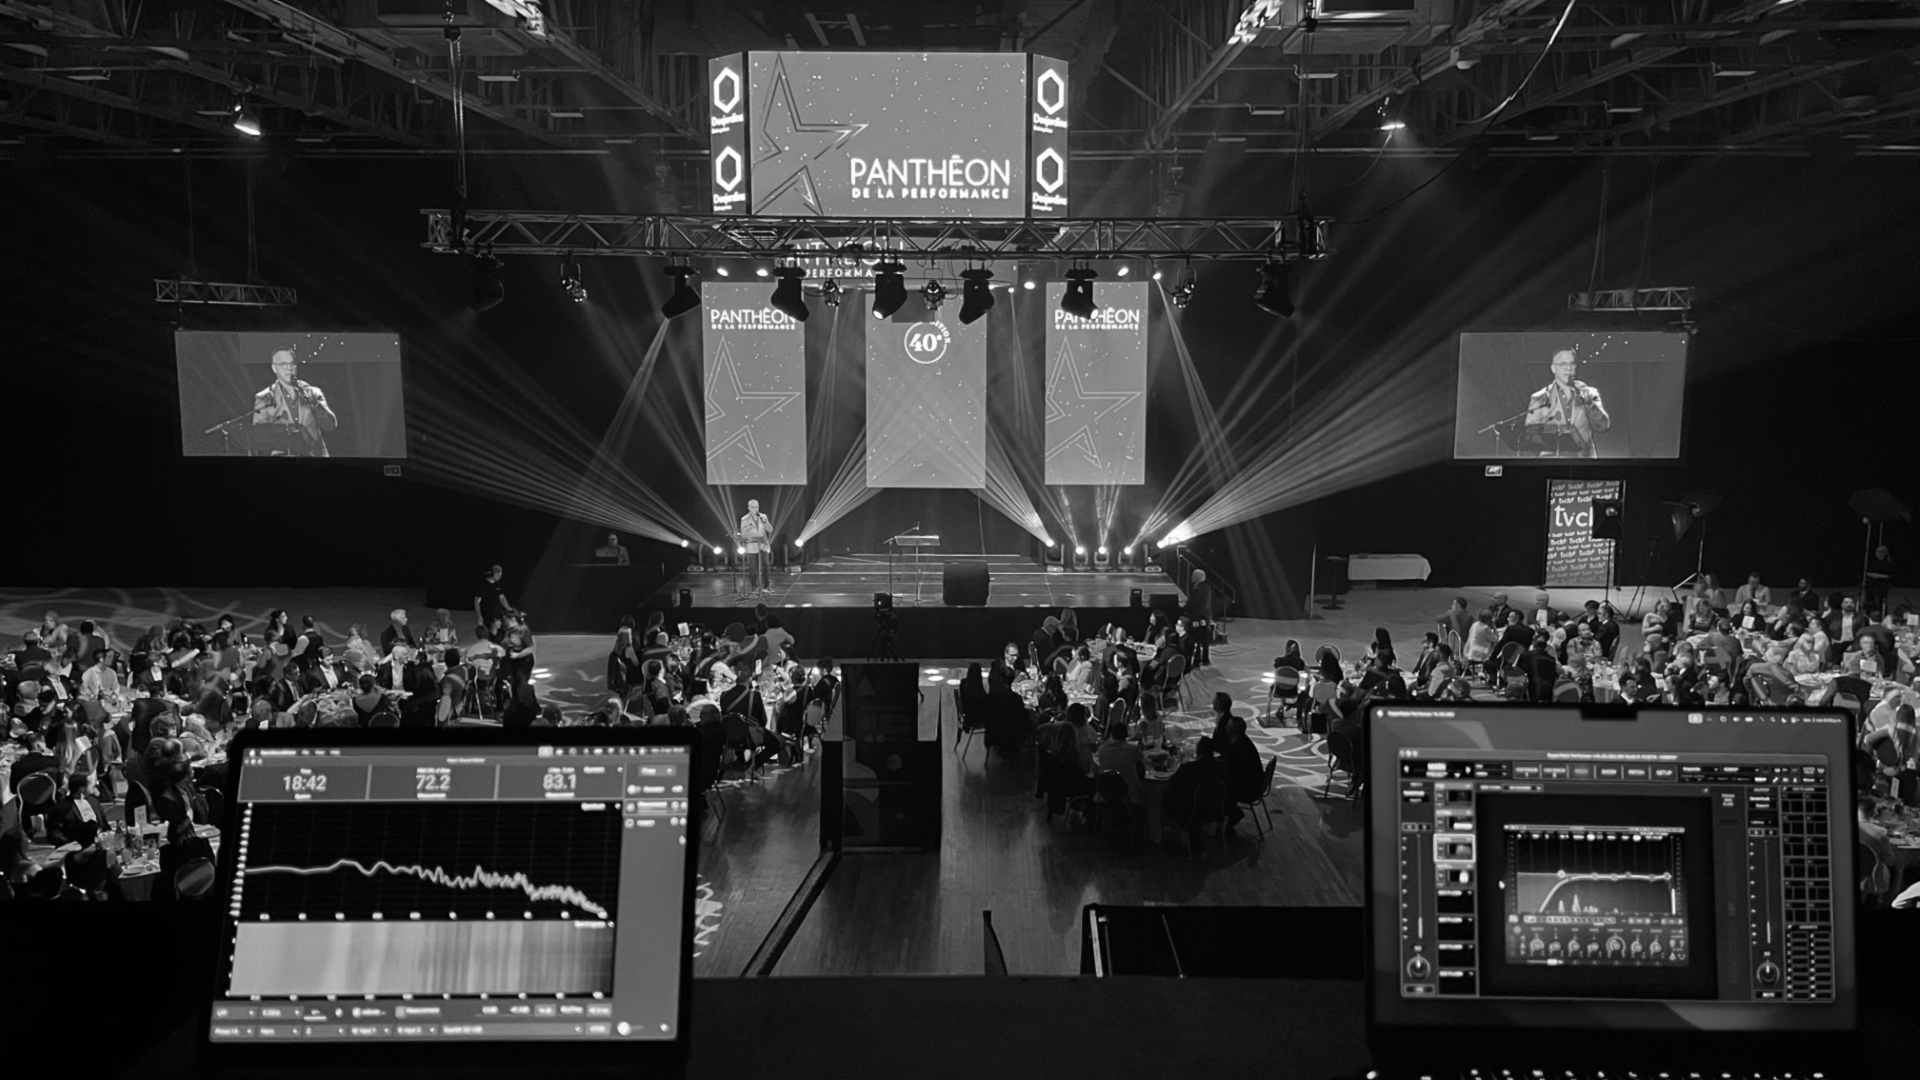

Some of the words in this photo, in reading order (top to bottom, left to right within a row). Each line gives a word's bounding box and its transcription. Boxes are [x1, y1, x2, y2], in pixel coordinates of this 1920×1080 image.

[852, 187, 870, 199] DE
[877, 187, 895, 199] LA
[901, 187, 1009, 199] PERFORMANCE
[805, 268, 874, 278] PERFORMA
[929, 320, 951, 344] ITION
[283, 775, 327, 791] 18:42
[416, 774, 450, 790] 72.2
[543, 774, 577, 790] 83.1
